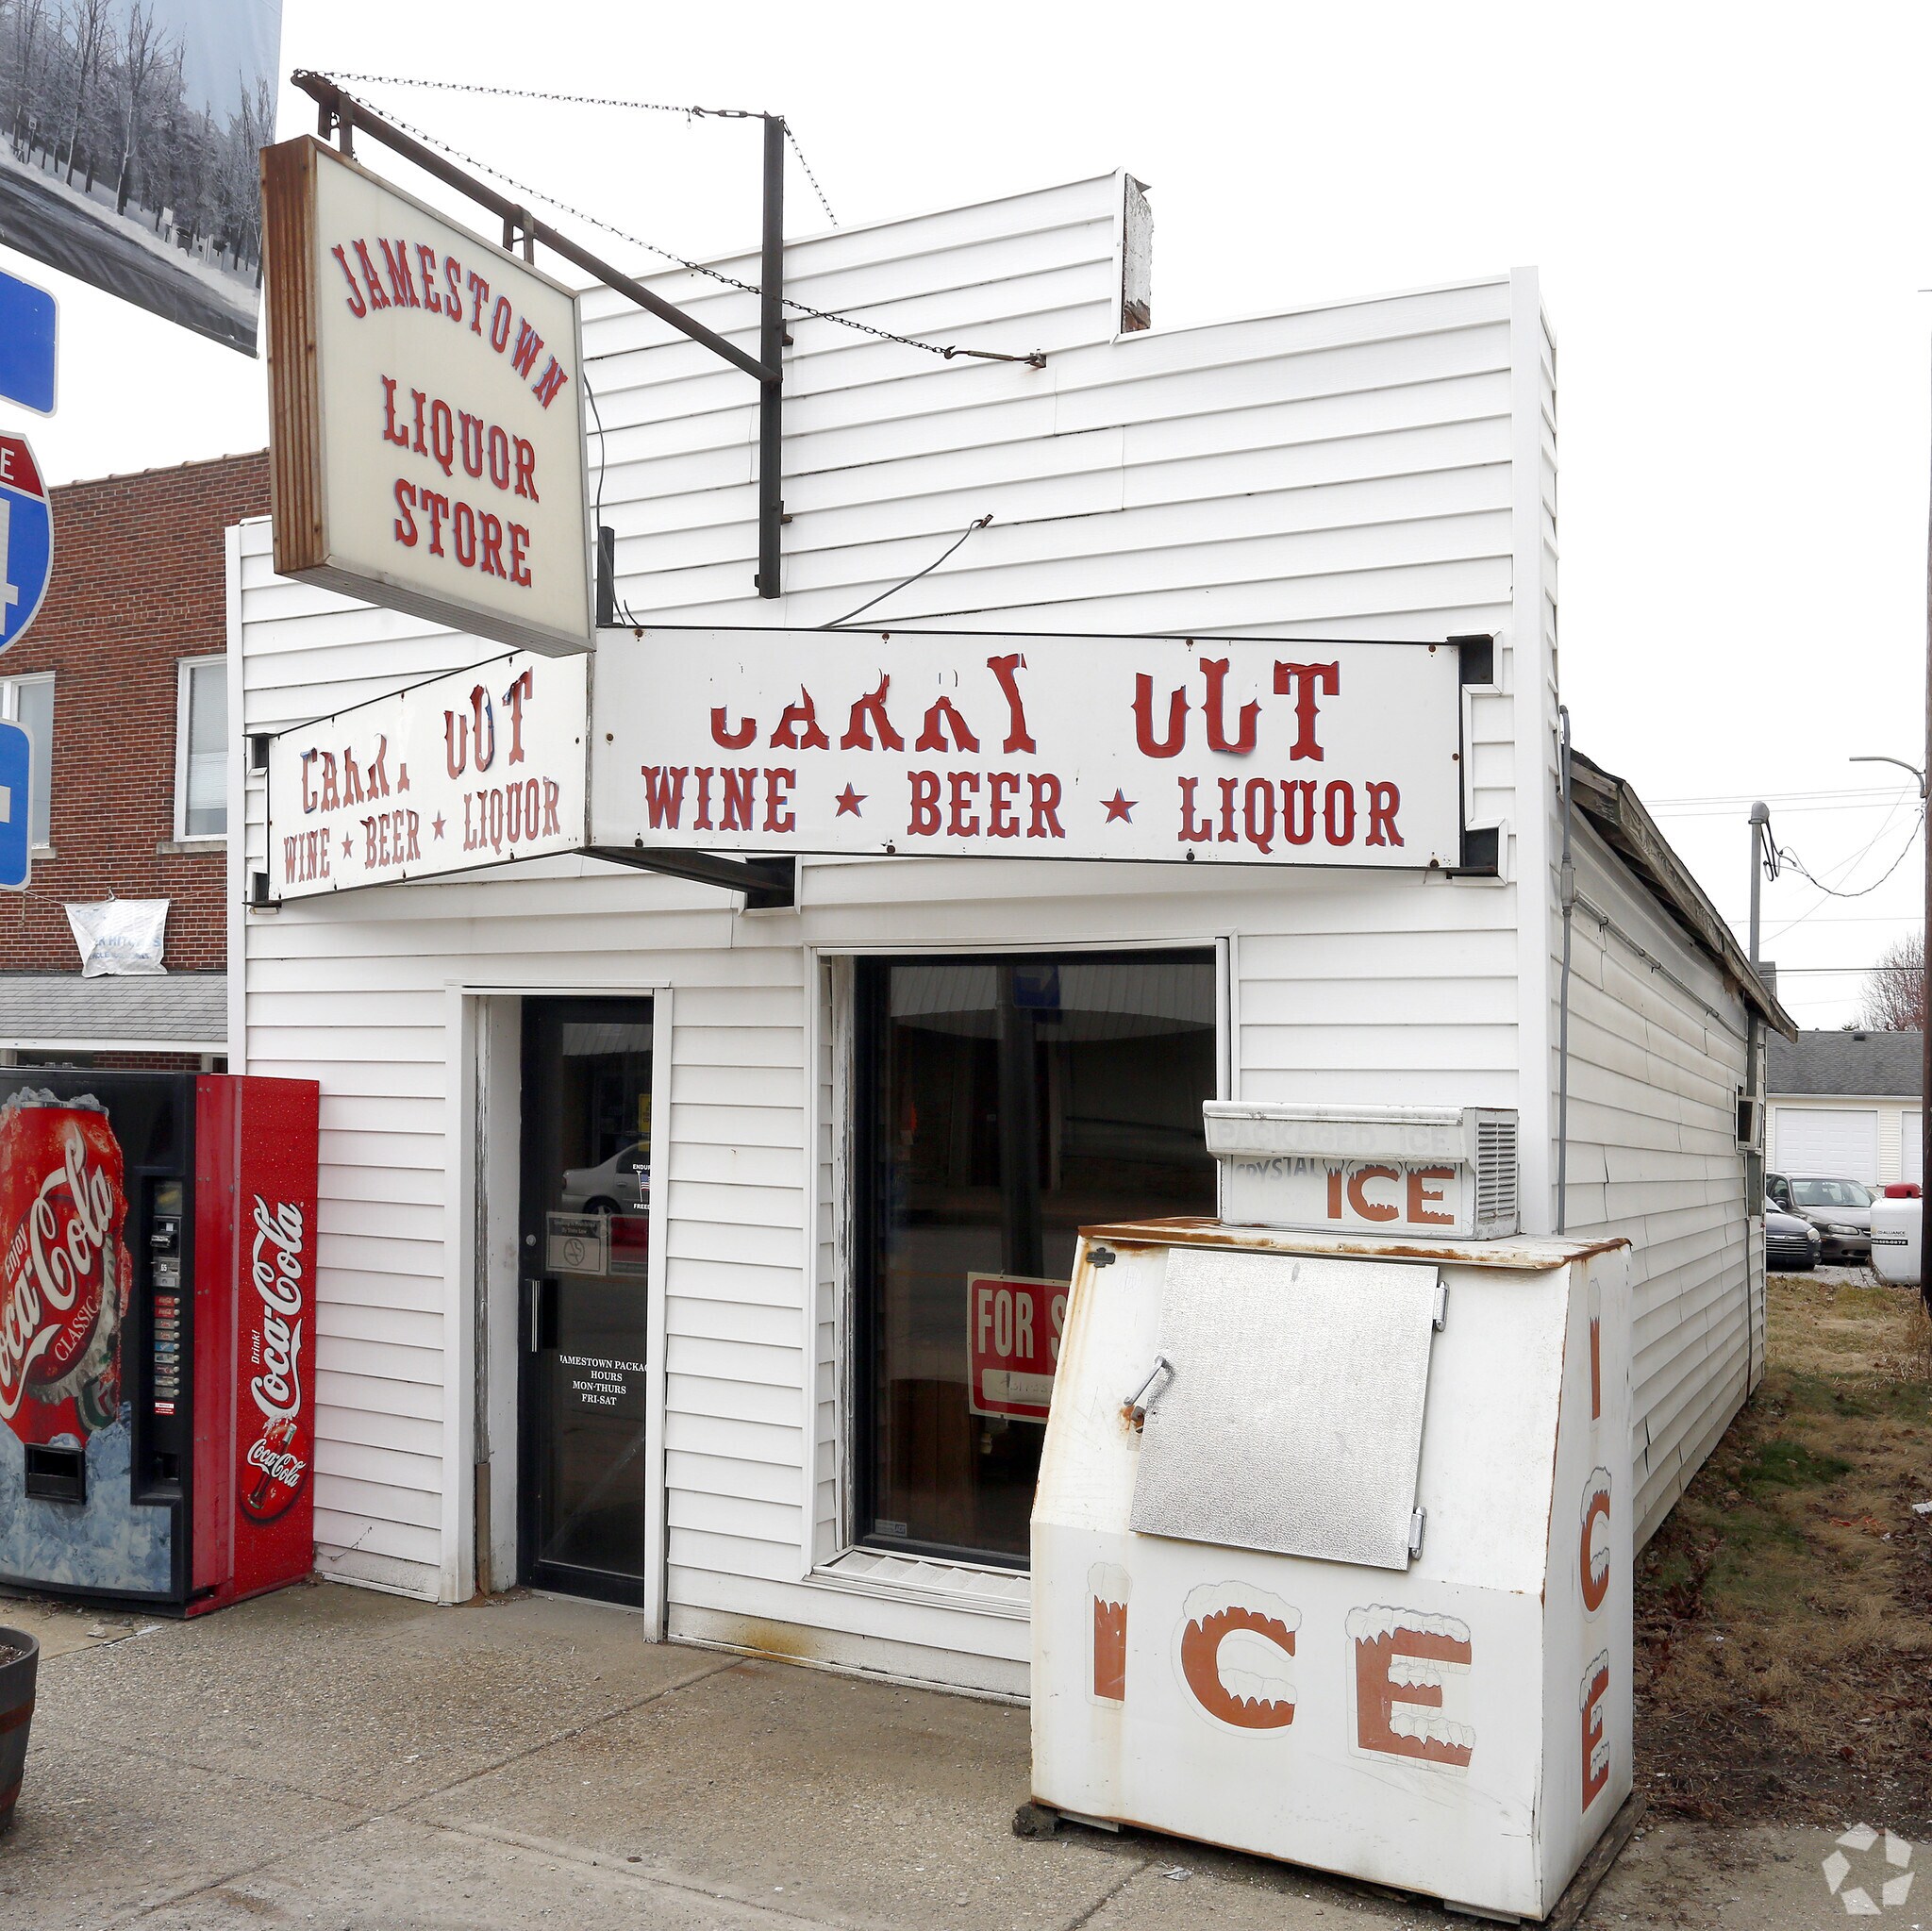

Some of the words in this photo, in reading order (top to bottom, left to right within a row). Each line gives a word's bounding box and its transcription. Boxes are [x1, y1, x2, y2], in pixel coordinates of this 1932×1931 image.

[331, 237, 569, 410] JAMESTOWN
[380, 374, 539, 503] LIQUOR
[393, 478, 532, 588] STORE
[443, 666, 533, 780] OUT
[283, 826, 330, 884] WINE
[359, 808, 421, 869] BEER
[463, 776, 560, 855] LIQUOR
[641, 765, 797, 833] WINE
[907, 770, 1066, 838] BEER
[1177, 776, 1405, 855] LIQUOR
[1324, 1160, 1457, 1225] ICE
[5, 1223, 27, 1282] Enjoy
[54, 1295, 100, 1361] CLASSIC
[251, 1193, 304, 1418] Coca-Cola
[978, 1289, 1034, 1358] FOR
[1050, 1294, 1067, 1361] S
[251, 1329, 260, 1365] Drink!
[559, 1355, 612, 1369] JAMESTOWN
[591, 1370, 623, 1382] HOURS
[573, 1380, 626, 1394] MON-THURS
[581, 1393, 617, 1406] FRI-SAT
[247, 1439, 307, 1488] Coca-Cola
[1579, 1280, 1611, 1815] ICE
[1088, 1564, 1476, 1771] ICE
